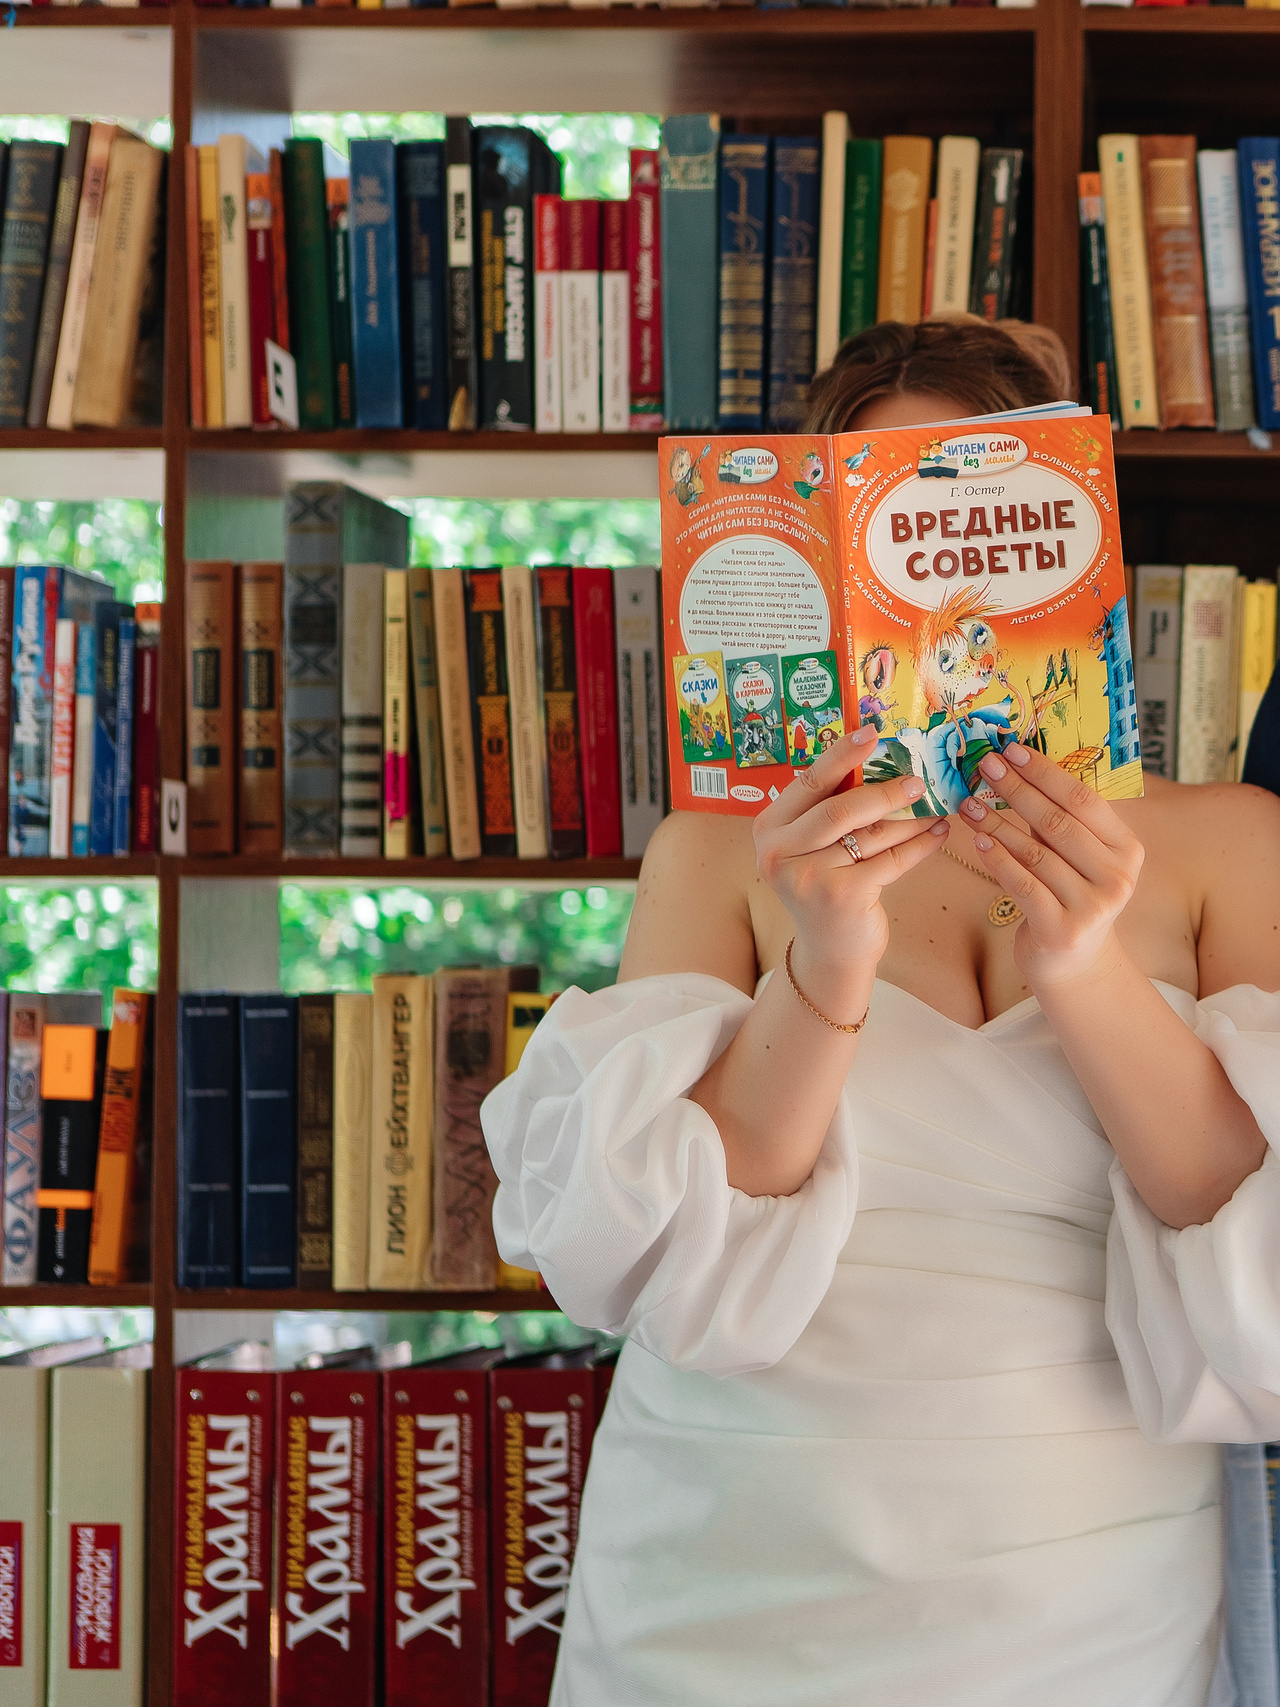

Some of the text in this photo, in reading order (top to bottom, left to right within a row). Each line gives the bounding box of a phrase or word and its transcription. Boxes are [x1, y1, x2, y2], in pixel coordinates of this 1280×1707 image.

[733, 455, 775, 466] ЧИТАЕМ САМИ
[943, 439, 1020, 457] ЧИТАЕМ САМИ
[963, 453, 1016, 469] без мамы
[688, 502, 710, 520] СЕРИЯ
[745, 493, 767, 502] САМИ
[768, 495, 782, 505] БЕЗ
[782, 499, 807, 516] МАМЫ
[846, 468, 884, 523] ЛЮБИМЫЕ
[852, 462, 914, 549] ДЕТСКИЕ ПИСАТЕЛИ
[950, 484, 1006, 499] Г. Остер
[1032, 450, 1114, 514] БОЛЬШИЕ БУКВЫ
[675, 530, 688, 545] ЭТО
[688, 516, 710, 535] КНИГИ
[710, 511, 725, 523] ДЛЯ
[774, 509, 783, 518] НЕ
[784, 512, 829, 547] СЛУШАТЕЛЕЙ!
[697, 517, 811, 544] ЧИТАЙ САМ БЕЗ ВЗРОСЛЫХ!
[890, 499, 1076, 544] ВРЕДНЫЕ
[905, 539, 1067, 582] СОВЕТЫ
[1009, 550, 1111, 626] ЛЕГКО ВЗЯТЬ С СОБОЙ
[848, 563, 913, 629] С УДАРЕНИЯМИ
[867, 577, 894, 607] СЛОВА
[682, 677, 718, 693] СКАЗКИ
[742, 679, 765, 689] СКАЗКИ
[793, 673, 828, 684] МАЛЕНЬКИЕ
[846, 624, 856, 686] ВРЕДНЫЕ СОВЕТЫ
[735, 687, 773, 699] В КАРТИНКАХ
[796, 682, 826, 692] СКАЗОЧКИ
[387, 993, 414, 1257] ЛИОН ФЕЙХТВАНГЕР
[6, 1066, 40, 1266] ФАУЛЗ
[185, 1414, 206, 1586] ПРАВОСЛАВНЫЕ
[286, 1416, 307, 1589] ПРАВОСЛАВНЫЕ
[396, 1413, 415, 1588] ПРАВОСЛАВНЫЕ
[504, 1410, 571, 1646] Храмы
[505, 1411, 525, 1584] ПРАВОСЛАВНЫЕ
[184, 1413, 263, 1650] Храмы
[285, 1415, 366, 1651] Храмы
[395, 1413, 477, 1649] Храмы
[76, 1526, 95, 1627] РИСОВАНИЯ
[94, 1548, 113, 1644] ЖИВОПИСИ
